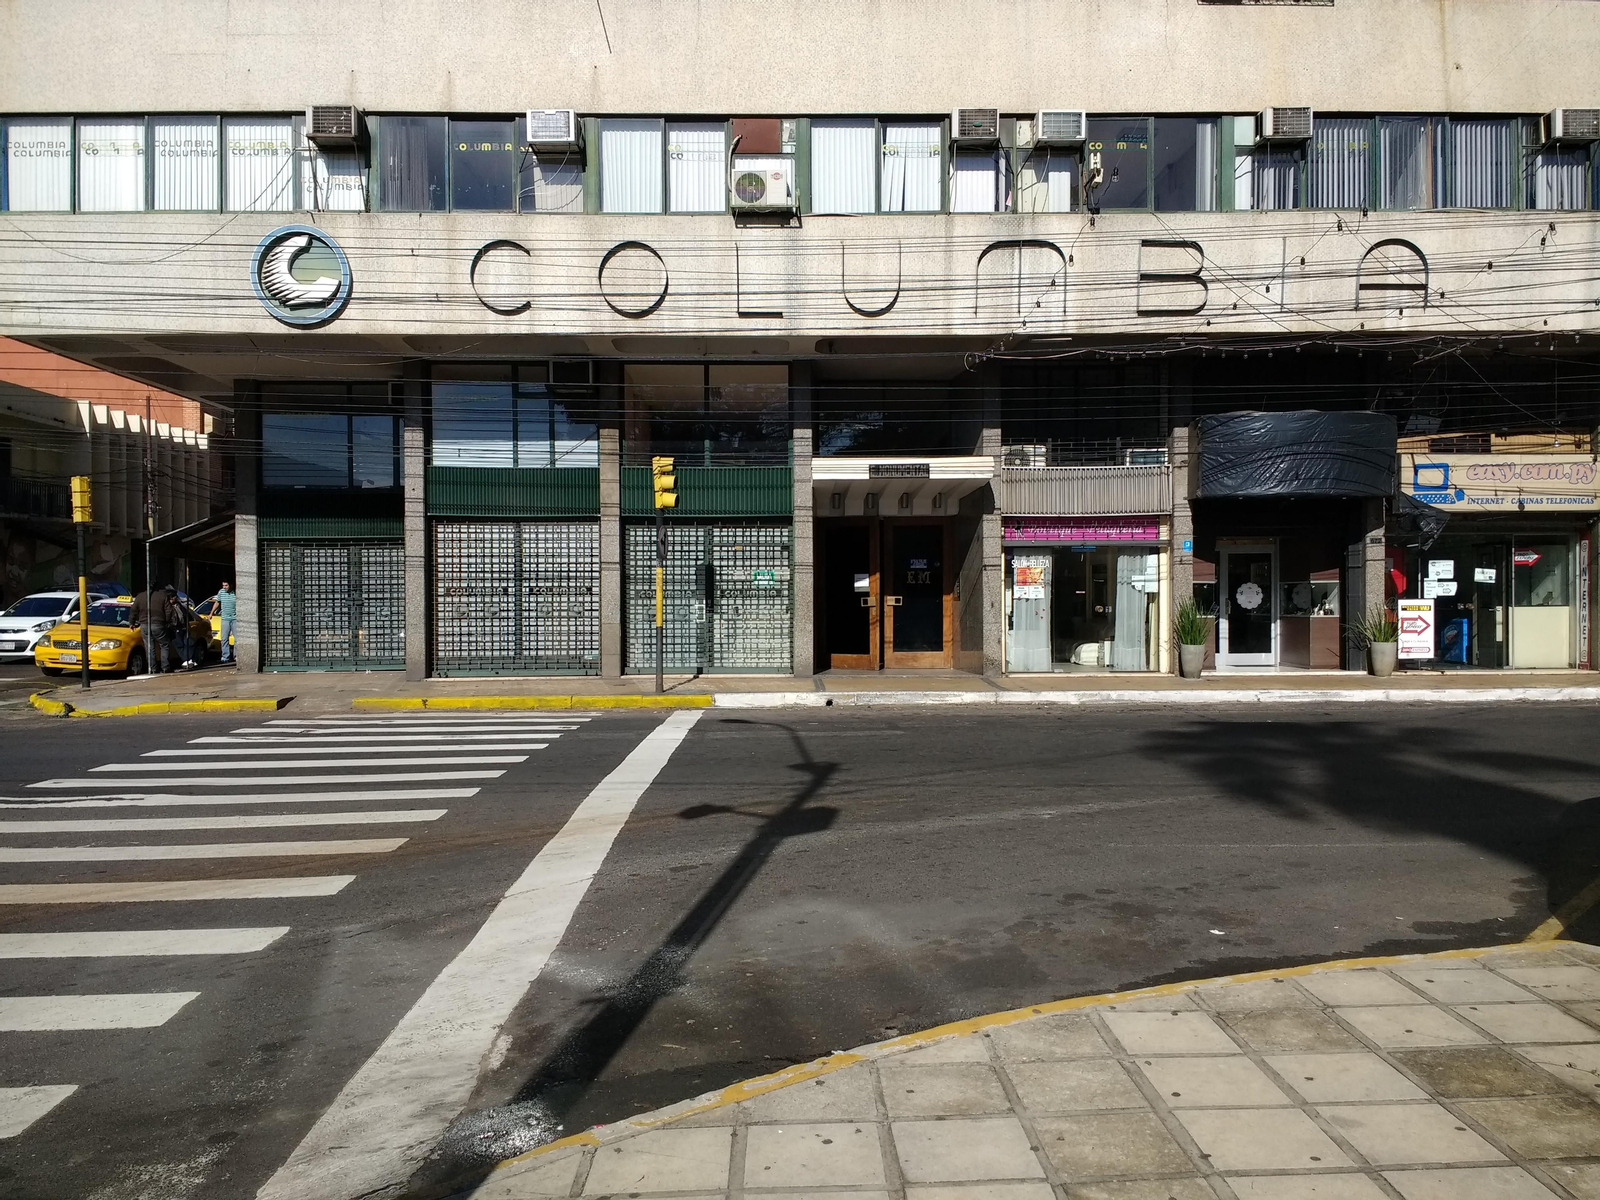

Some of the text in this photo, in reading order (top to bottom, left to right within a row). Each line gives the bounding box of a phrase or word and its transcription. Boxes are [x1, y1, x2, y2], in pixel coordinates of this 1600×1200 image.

[453, 142, 512, 151] COLUMBIA
[470, 238, 1430, 319] COLUMBIA
[1466, 462, 1597, 484] easy.com.py
[1467, 497, 1595, 505] INTERNET CABINAS TELEFONICAS
[724, 590, 777, 598] COLUMBIA
